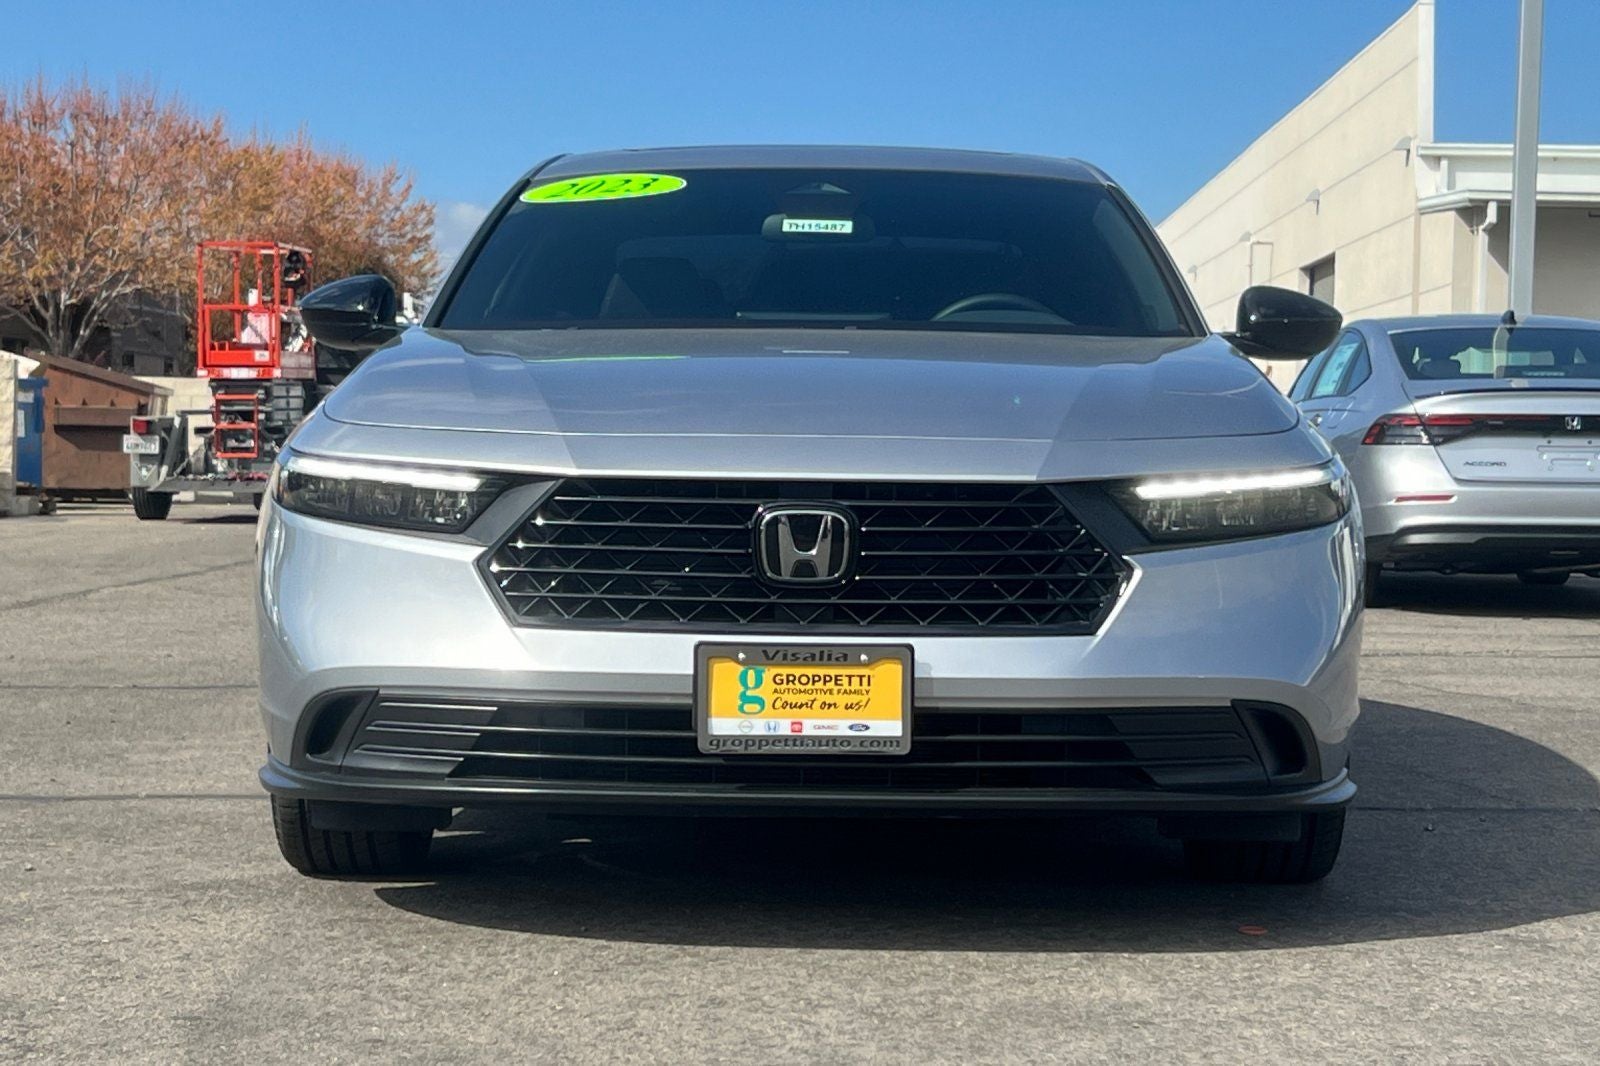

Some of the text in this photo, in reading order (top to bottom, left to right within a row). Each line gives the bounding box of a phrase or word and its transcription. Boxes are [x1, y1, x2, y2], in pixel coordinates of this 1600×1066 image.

[543, 177, 660, 199] 2023
[761, 649, 849, 662] Visalia
[772, 673, 871, 687] GROPPETTI
[772, 688, 871, 696] AUTOMOTIVE FAMILY
[772, 696, 871, 712] Count on us!
[708, 737, 900, 751] groppettiauto.com
